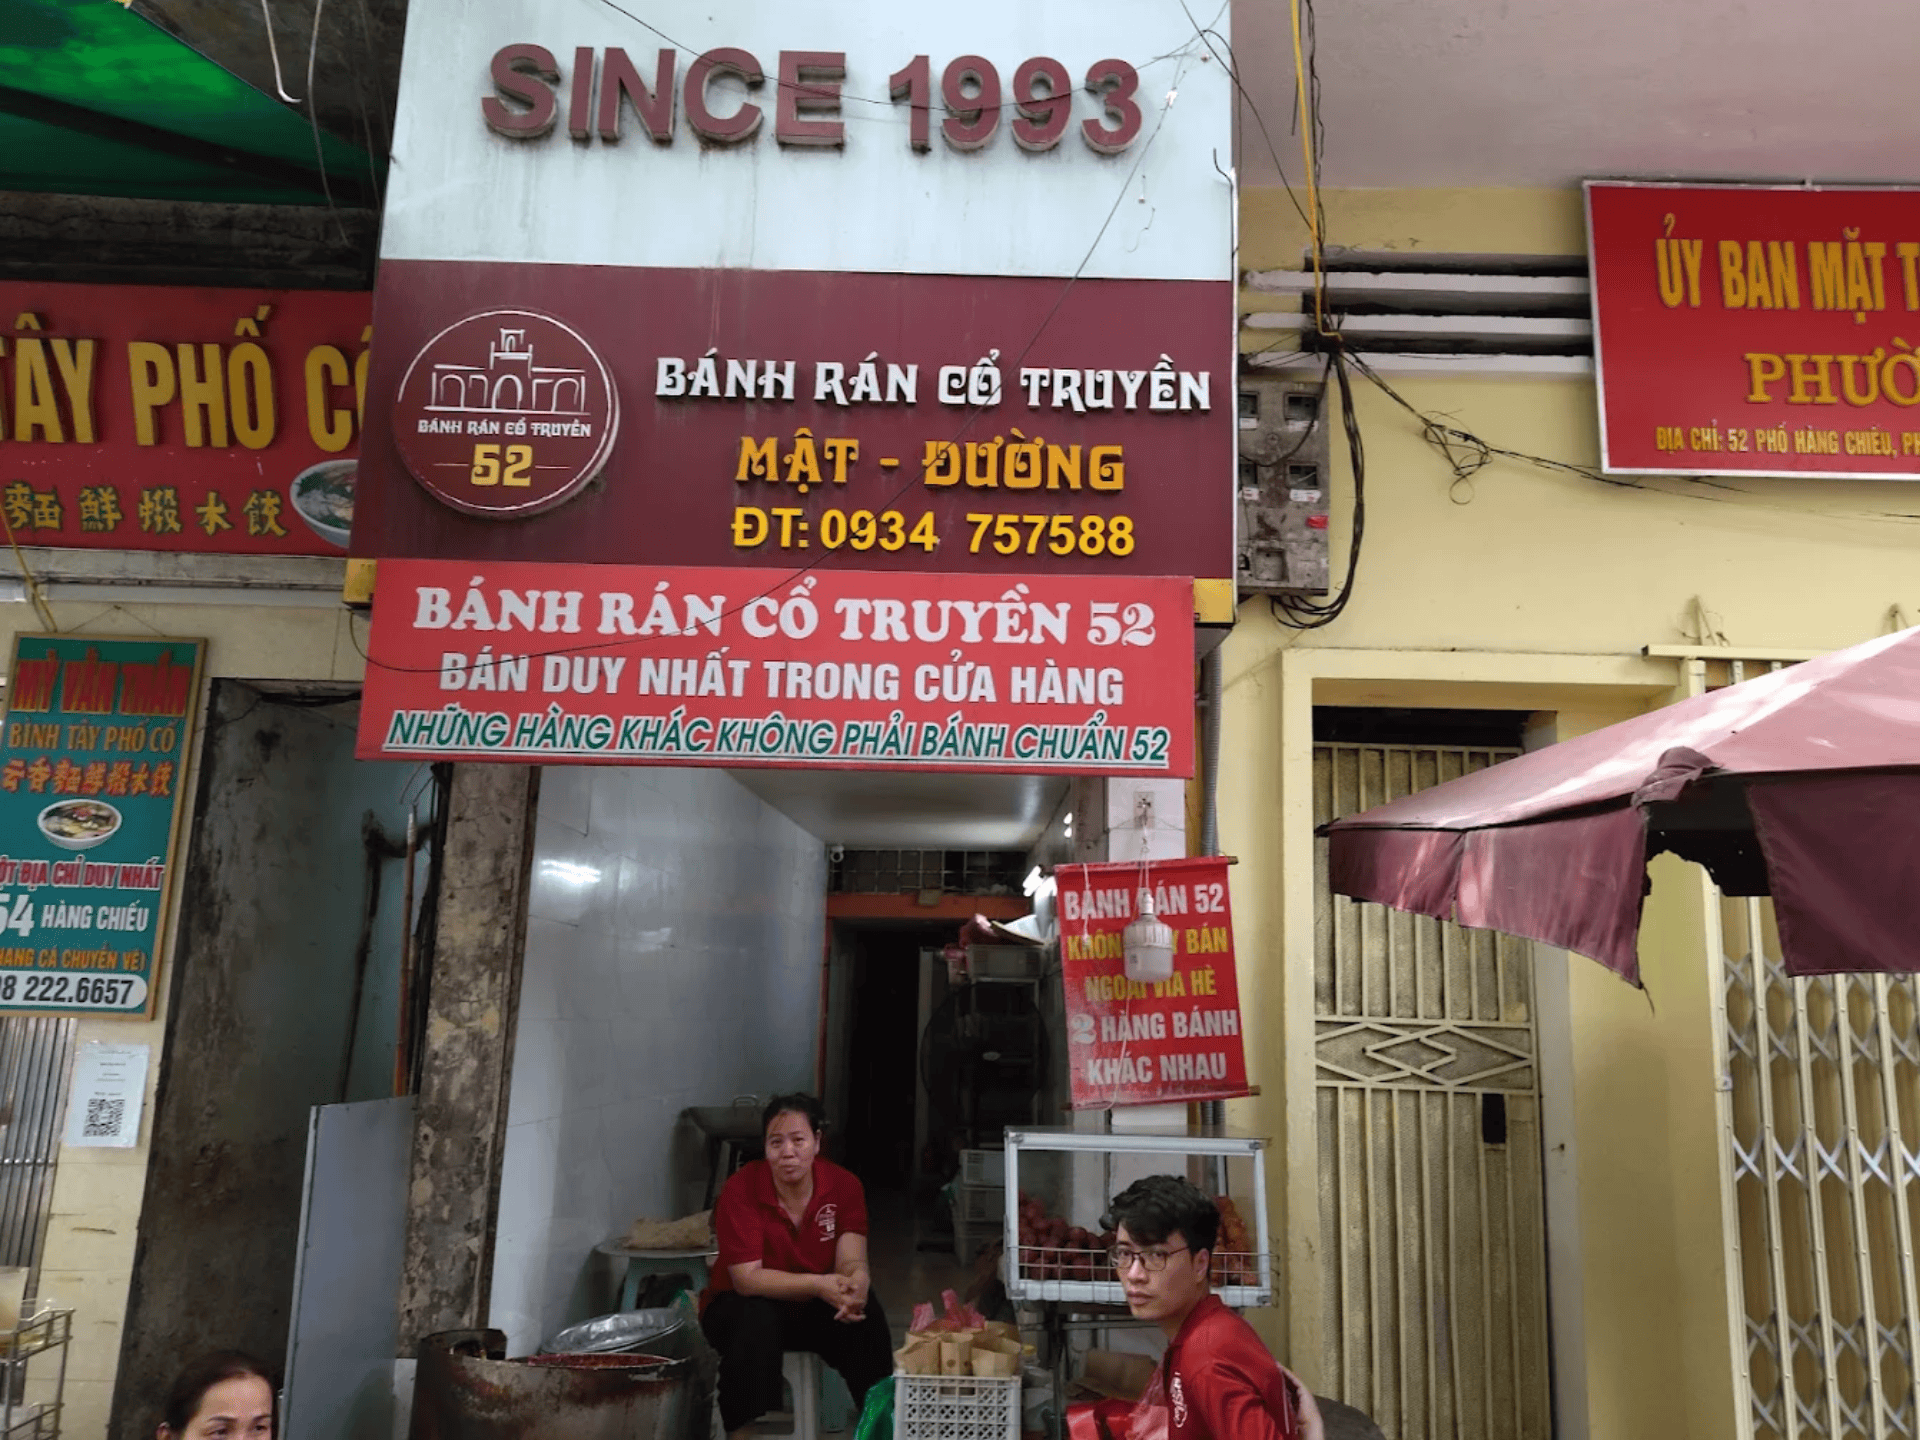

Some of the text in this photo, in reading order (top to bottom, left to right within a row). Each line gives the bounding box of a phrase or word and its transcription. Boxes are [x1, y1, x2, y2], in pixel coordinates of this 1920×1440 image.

[481, 43, 1143, 152] SINCE 1993
[1655, 213, 1703, 308] ỦY
[1718, 240, 1801, 310] BAN
[1807, 226, 1886, 324] MẶT
[0, 313, 95, 443] ÂY
[127, 305, 276, 449] PHỐ
[655, 348, 1211, 412] BÁNH RÁN CỔ TRUYỀN
[1744, 336, 1920, 406] PHƯỜ
[417, 418, 463, 434] BÁNH
[467, 419, 500, 436] RÁN
[530, 419, 592, 437] TRUYỀN
[1728, 428, 1749, 452] 52
[1755, 421, 1789, 453] PHỐ
[1794, 424, 1838, 454] HÀNG
[471, 444, 533, 487] 52
[735, 427, 859, 493] MẬT
[922, 427, 1125, 490] ĐƯỜNG
[731, 507, 1135, 557] ĐT: 0934 757588
[413, 576, 1156, 646] BÁNH RÁN CỔ TRUYỀN 52
[439, 645, 1124, 705] BÁN DUY NHẤT TRONG CỬA HÀNG
[67, 719, 101, 750] TÂY
[104, 718, 150, 752] PHỐ
[387, 701, 1170, 761] NHỮNG HÀNG KHÁC KHÔNG PHẢI BÁNH CHUẨN 52
[0, 855, 166, 890] ỘT ĐỊA CHỈ DUY NHẤT
[40, 899, 93, 929] HÀNG
[96, 899, 149, 932] CHIẾU
[1194, 883, 1225, 914] 52
[1067, 929, 1123, 961] KHÔN
[1185, 922, 1229, 955] BÁN
[0, 975, 135, 1005] 8 222.6657
[1190, 965, 1217, 996] HÈ
[1070, 1006, 1238, 1045] 2 HÀNG BÁNH
[1087, 1052, 1227, 1086] KHÁC NHAU
